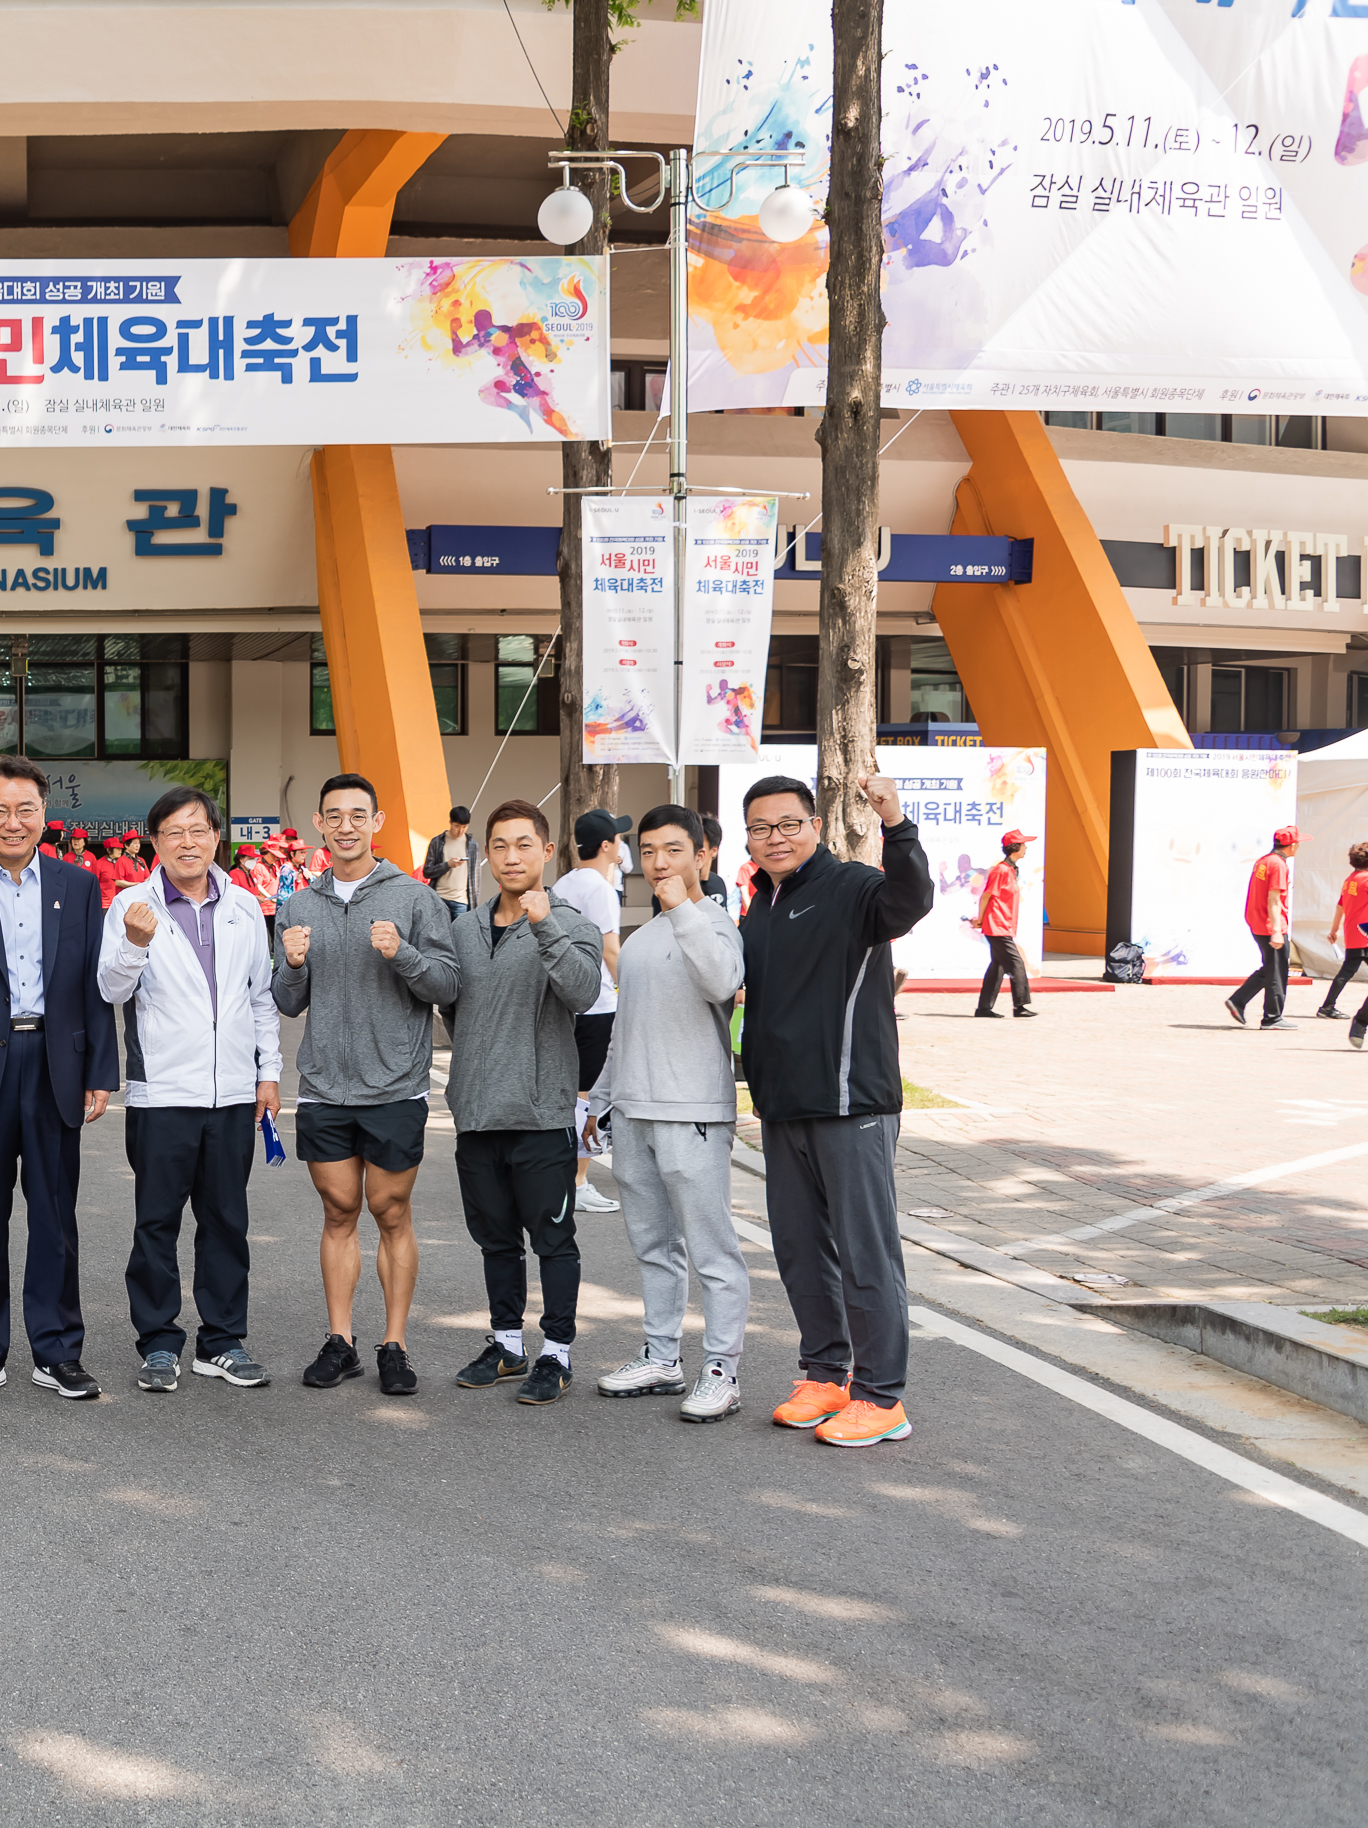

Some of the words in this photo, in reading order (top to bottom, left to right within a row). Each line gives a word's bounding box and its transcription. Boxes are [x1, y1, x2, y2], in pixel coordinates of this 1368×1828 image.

[1040, 112, 1201, 153] 2019.5.11.(토)
[1233, 122, 1313, 163] 12.(일)
[1029, 173, 1085, 210] 잠실
[1090, 175, 1230, 217] 실내체육관
[1237, 184, 1284, 219] 일원
[44, 281, 82, 301] 성공
[86, 281, 123, 301] 개최
[129, 281, 166, 301] 기원
[544, 322, 573, 332] SEOUL
[575, 322, 594, 332] 2019
[1101, 386, 1149, 399] 서울특별시
[1150, 387, 1205, 401] 회원종목단체
[44, 399, 69, 413] 잠실
[73, 399, 136, 413] 실내체육관
[140, 398, 165, 413] 일원
[630, 546, 655, 555] 2019
[735, 548, 759, 558] 2019
[458, 556, 472, 567] 1층
[474, 556, 500, 567] 출입구
[1163, 523, 1348, 613] TICKET
[950, 565, 963, 575] 2층
[966, 565, 989, 576] 출입구
[593, 577, 663, 593] 체육대축전
[696, 579, 764, 595] 체육대축전
[935, 735, 983, 747] TICKET
[1213, 753, 1231, 761] 2019
[1145, 767, 1181, 778] 제100회
[1183, 767, 1239, 779] 전국체육대회
[903, 778, 921, 789] 성공
[922, 779, 939, 790] 개최
[940, 779, 958, 790] 기원
[902, 800, 1005, 826] 체육대축전
[240, 825, 271, 840] 내-3
